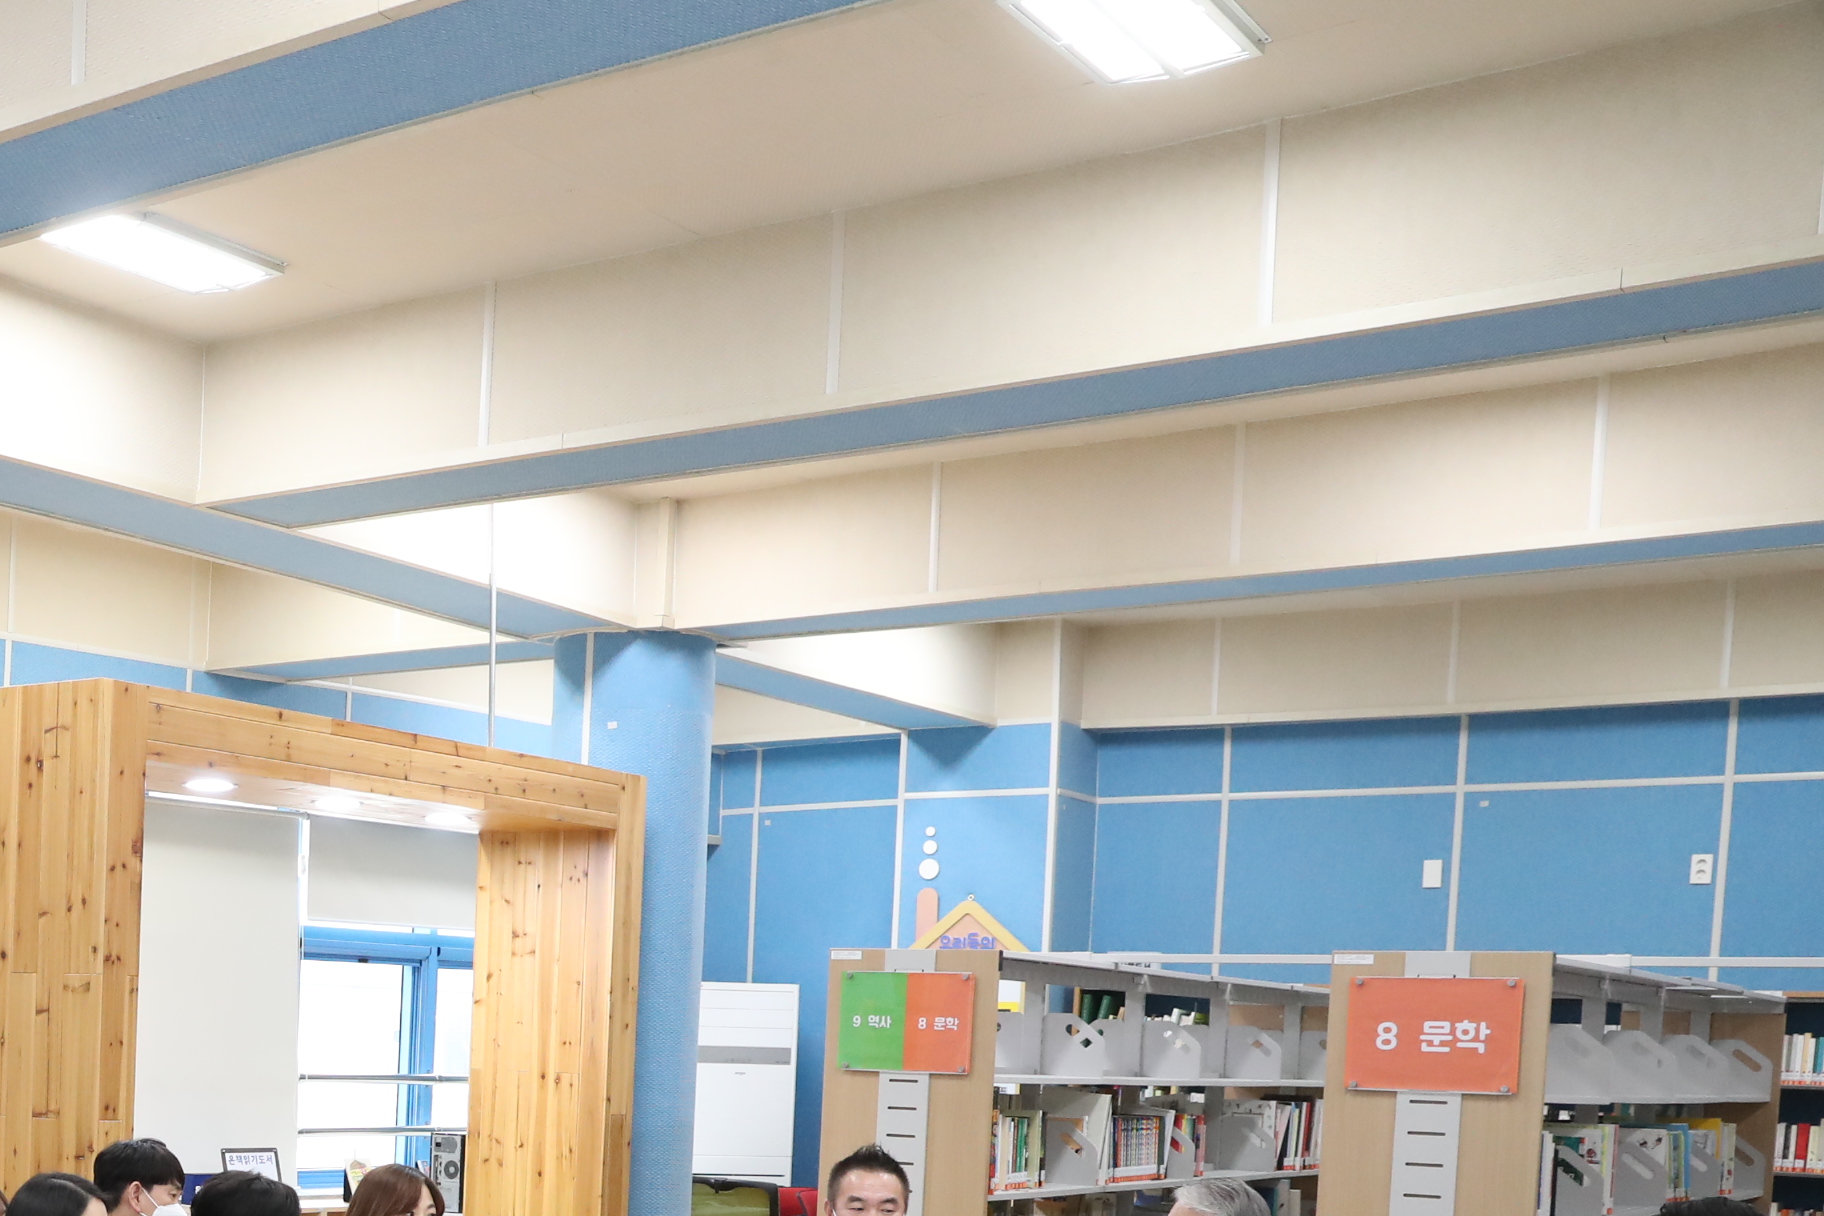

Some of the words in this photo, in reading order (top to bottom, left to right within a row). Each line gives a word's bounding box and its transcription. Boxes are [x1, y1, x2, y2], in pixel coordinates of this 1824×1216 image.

[852, 1015, 861, 1027] 9
[868, 1015, 892, 1028] 역사
[917, 1017, 927, 1029] 8
[933, 1017, 959, 1030] 문학
[1376, 1022, 1398, 1050] 8
[1419, 1020, 1491, 1053] 문학
[228, 1154, 273, 1165] 온책읽기도서
